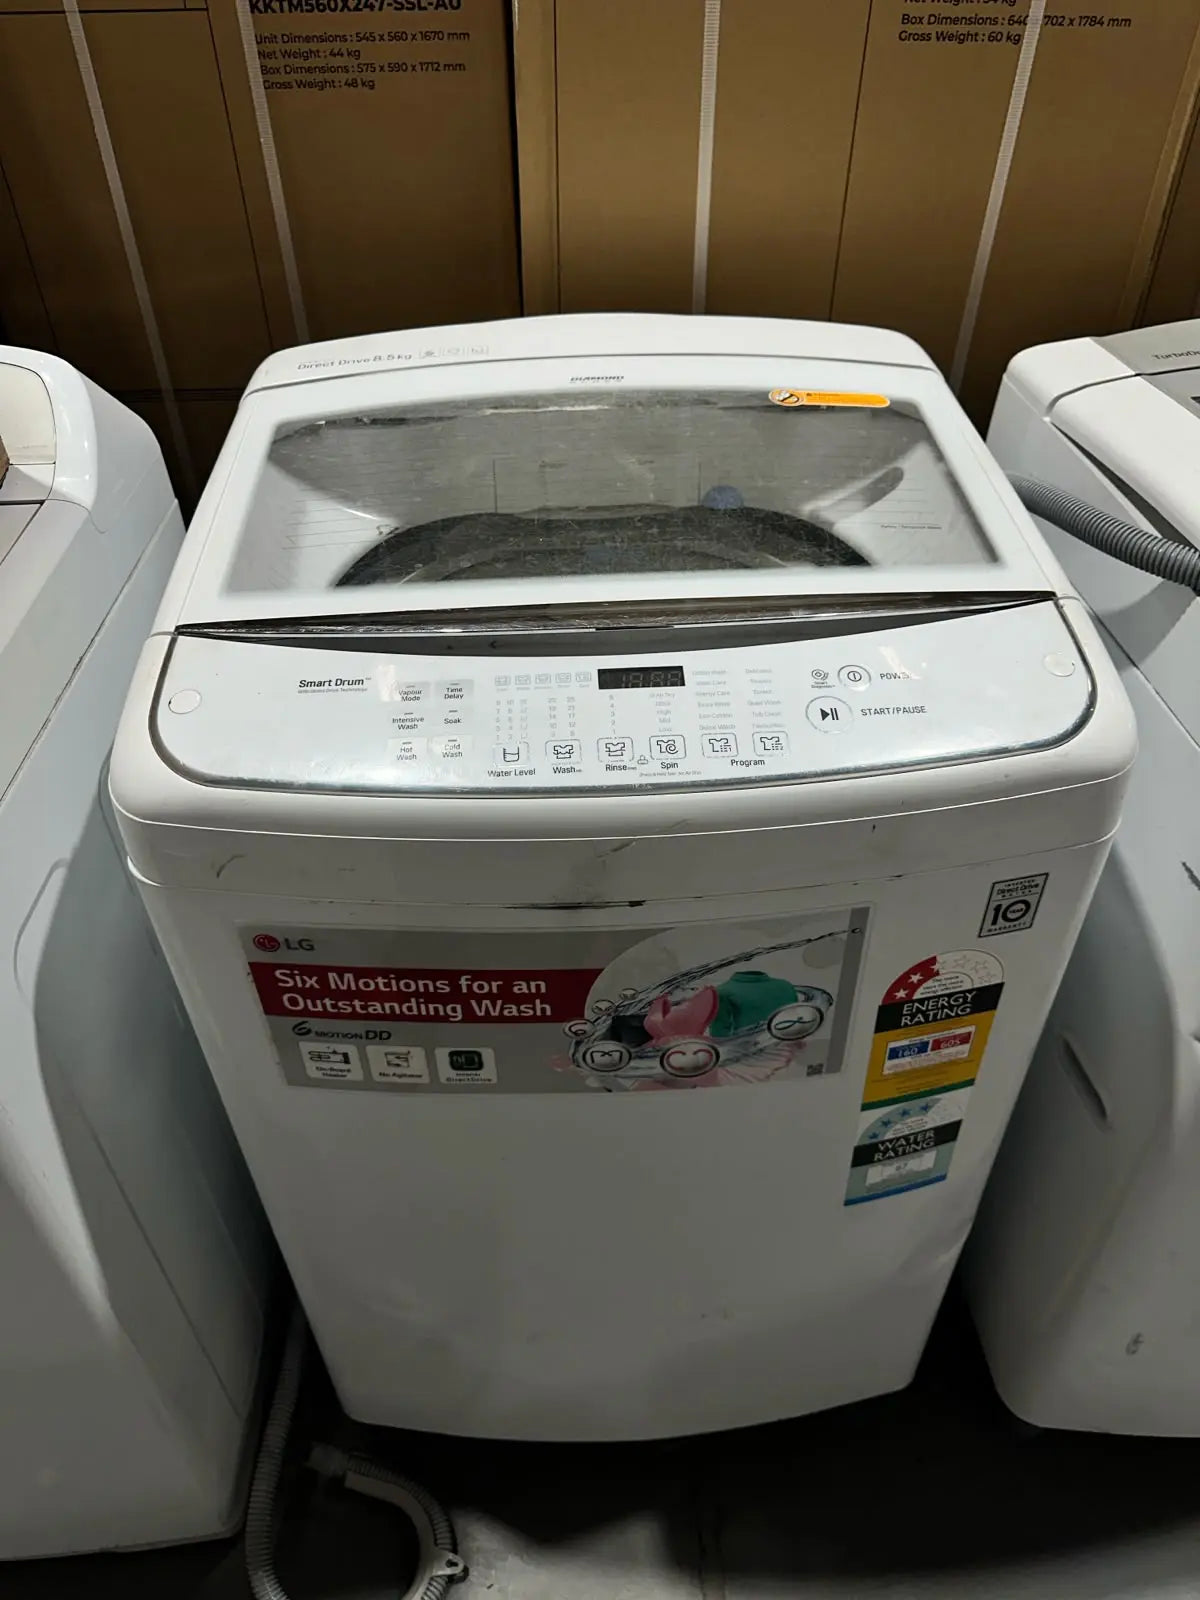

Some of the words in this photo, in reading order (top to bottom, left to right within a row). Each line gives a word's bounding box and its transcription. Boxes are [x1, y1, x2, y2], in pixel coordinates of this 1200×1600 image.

[901, 13, 925, 25] Box
[927, 12, 999, 26] Dimensions
[1043, 15, 1065, 27] 702
[1067, 18, 1075, 26] x
[1077, 15, 1104, 27] 1784
[1106, 17, 1132, 27] mm
[254, 33, 279, 45] Unit
[281, 32, 348, 44] Dimensions
[355, 31, 376, 42] 545
[378, 34, 386, 42] x
[387, 31, 408, 42] 560
[419, 31, 445, 41] 1670
[447, 32, 470, 41] mm
[898, 30, 932, 42] Gross
[935, 30, 979, 44] Weight
[987, 31, 1004, 42] 60
[1005, 31, 1022, 45] kg
[257, 49, 277, 60] Net
[280, 48, 321, 61] Weight
[328, 48, 344, 58] 44
[346, 48, 361, 61] kg
[260, 64, 281, 75] Box
[284, 63, 349, 75] Dimensions
[357, 63, 376, 73] 575
[378, 65, 386, 73] x
[387, 62, 408, 72] 590
[410, 64, 418, 72] x
[419, 62, 441, 72] 1712
[443, 63, 466, 72] mm
[262, 79, 293, 91] Gross
[294, 78, 337, 92] Weight
[343, 78, 359, 88] 48
[361, 77, 376, 91] kg
[297, 361, 335, 370] Direct
[338, 358, 370, 366] Drive
[298, 679, 333, 688] Smart
[398, 689, 423, 697] Vapour
[860, 705, 928, 717] START/PAUSE
[443, 717, 463, 725] Soak
[444, 743, 461, 751] Cold
[396, 753, 417, 761] Wash
[730, 758, 766, 769] Program
[552, 765, 576, 775] Wash
[605, 763, 627, 772] Rinse
[660, 761, 679, 771] Spin
[487, 769, 513, 778] Water
[514, 768, 536, 777] Level
[990, 898, 1032, 926] 10
[284, 938, 315, 951] LG
[274, 969, 321, 990] Six
[327, 971, 451, 994] Motions
[458, 974, 505, 994] for
[512, 979, 547, 994] an
[282, 992, 463, 1022] Outstanding
[470, 998, 552, 1017] Wash
[902, 990, 977, 1015] ENERGY
[900, 1003, 973, 1027] RATING
[365, 1029, 392, 1041] DD
[878, 1129, 935, 1151] WATER
[873, 1138, 935, 1161] RATING
